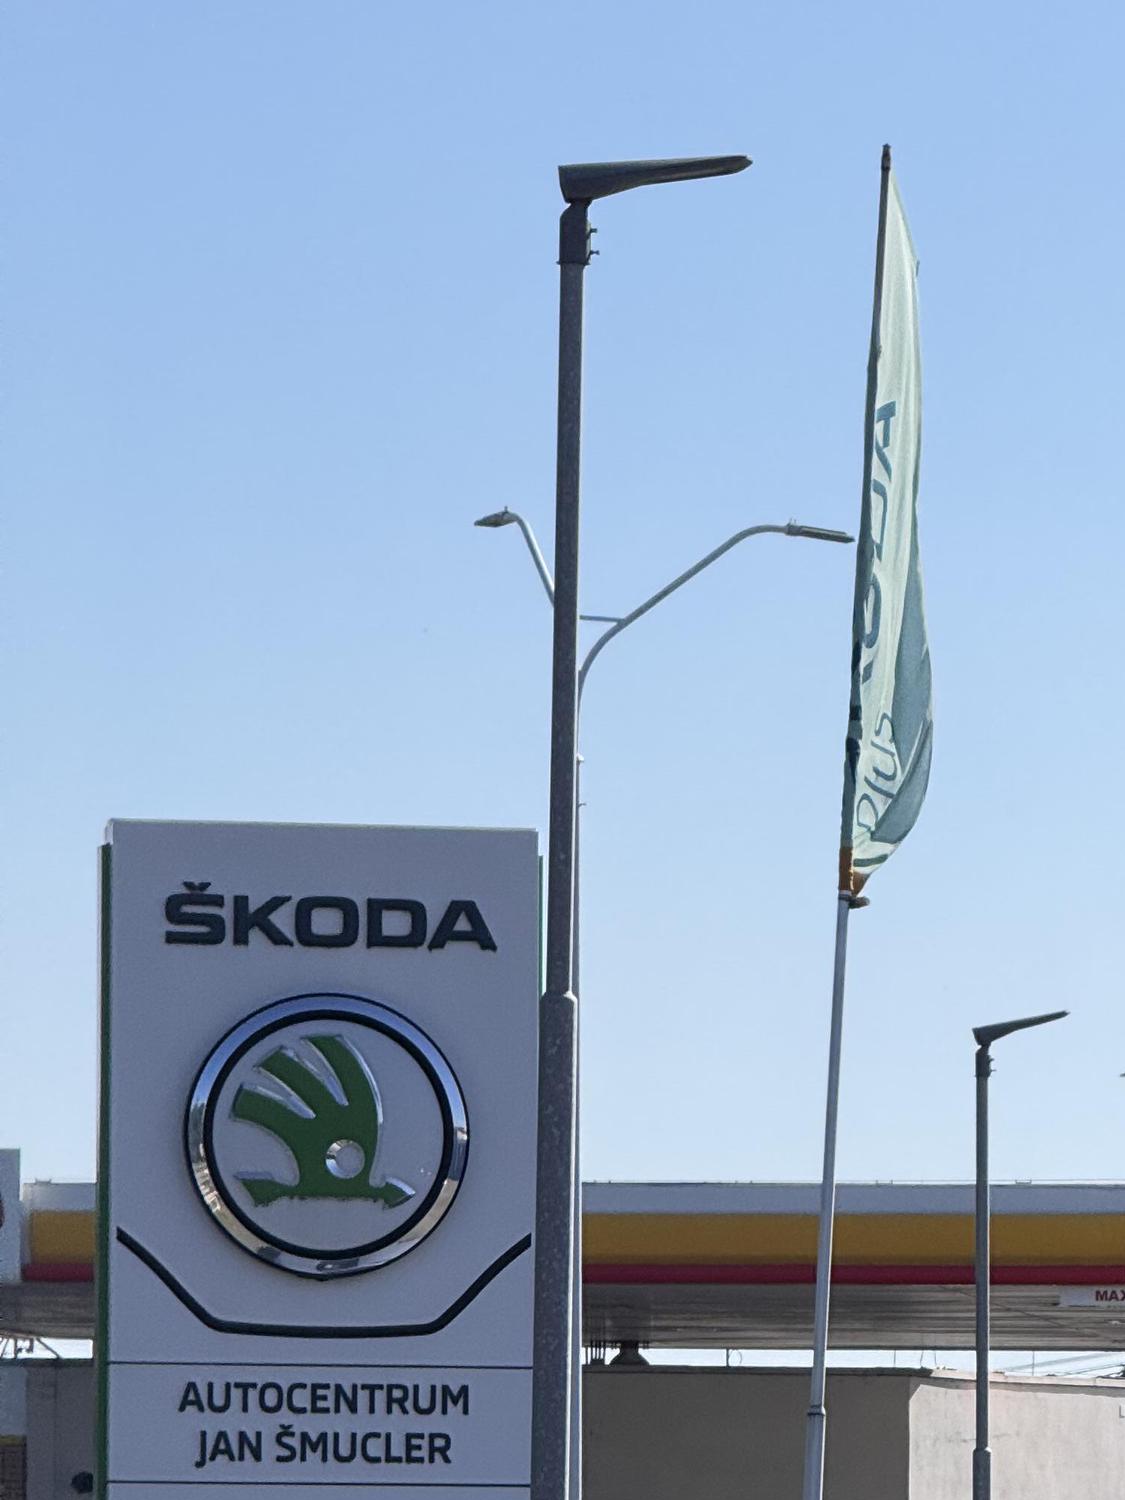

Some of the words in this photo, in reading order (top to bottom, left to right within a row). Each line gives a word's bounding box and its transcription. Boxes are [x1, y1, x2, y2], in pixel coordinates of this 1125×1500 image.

[164, 881, 498, 953] ŠKODA
[178, 1381, 470, 1416] AUTOCENTRUM
[194, 1430, 263, 1468] JAN
[274, 1424, 452, 1464] ŠMUCLER
